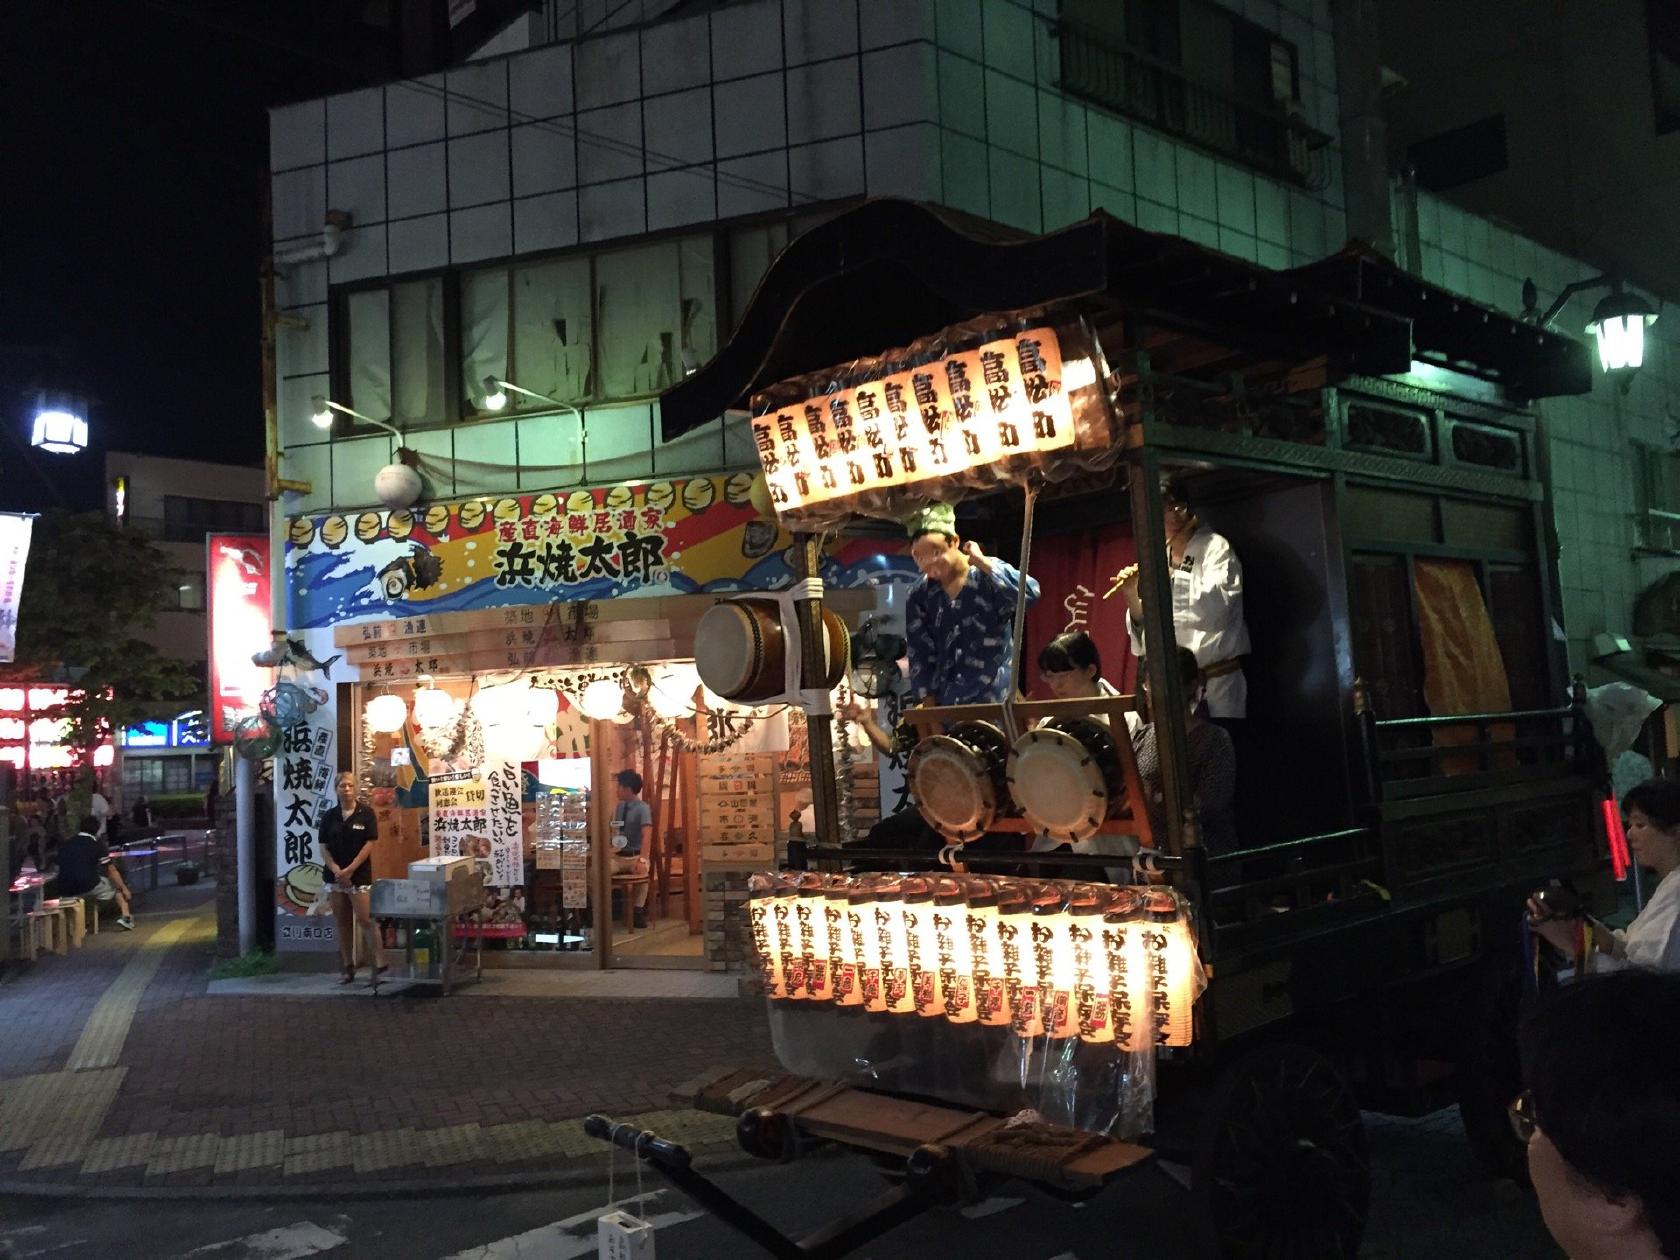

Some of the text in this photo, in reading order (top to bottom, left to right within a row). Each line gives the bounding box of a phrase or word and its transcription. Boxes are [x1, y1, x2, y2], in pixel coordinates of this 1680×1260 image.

[499, 507, 663, 543] 産直海鮮居酒家
[494, 531, 666, 586] 浜焼太郎
[283, 720, 313, 865] 浜焼太郎
[433, 817, 487, 834] 浜焼太郎
